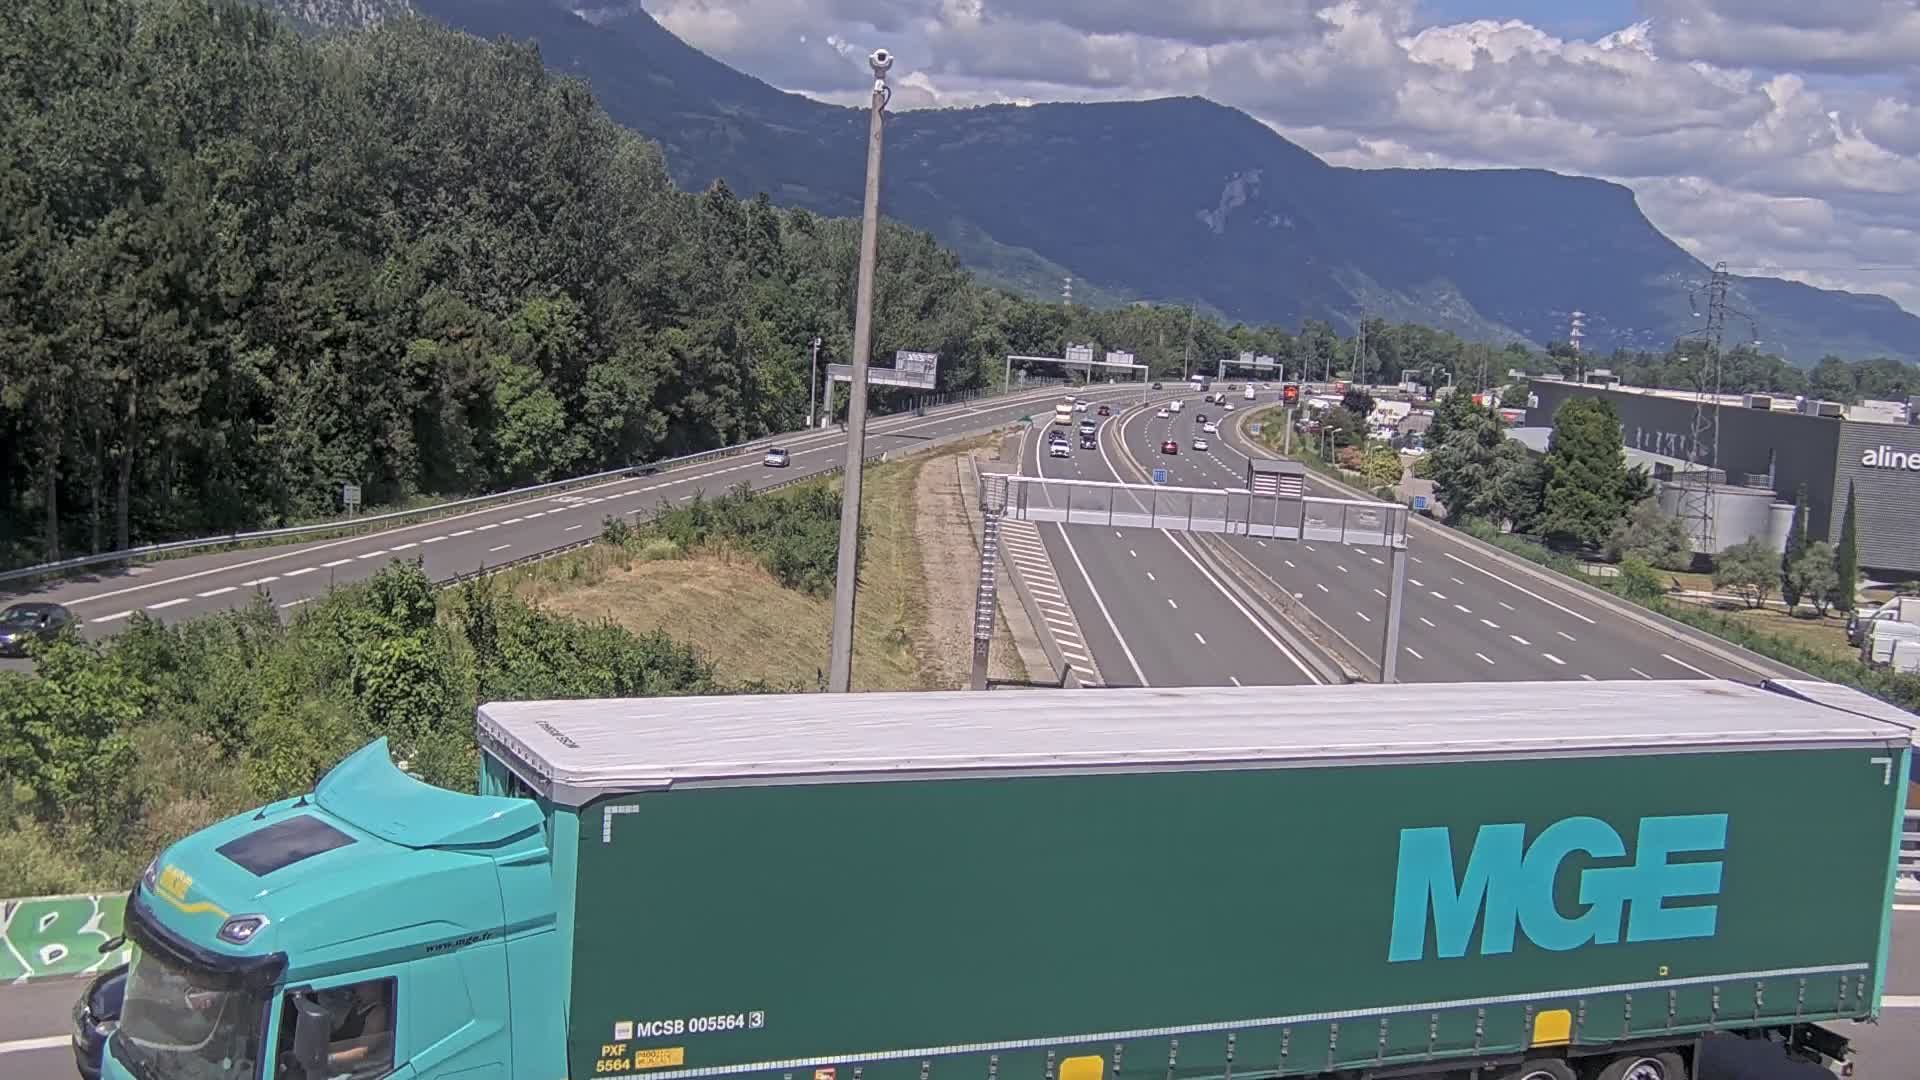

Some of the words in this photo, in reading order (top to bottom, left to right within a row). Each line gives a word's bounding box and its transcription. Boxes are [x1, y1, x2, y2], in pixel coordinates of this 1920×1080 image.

[1862, 445, 1920, 470] aline
[1388, 813, 1728, 962] MGE
[637, 1020, 684, 1037] MCSB
[688, 1013, 744, 1033] 005564
[750, 1012, 763, 1028] 3
[602, 1043, 626, 1057] PXF
[596, 1058, 630, 1073] 5564
